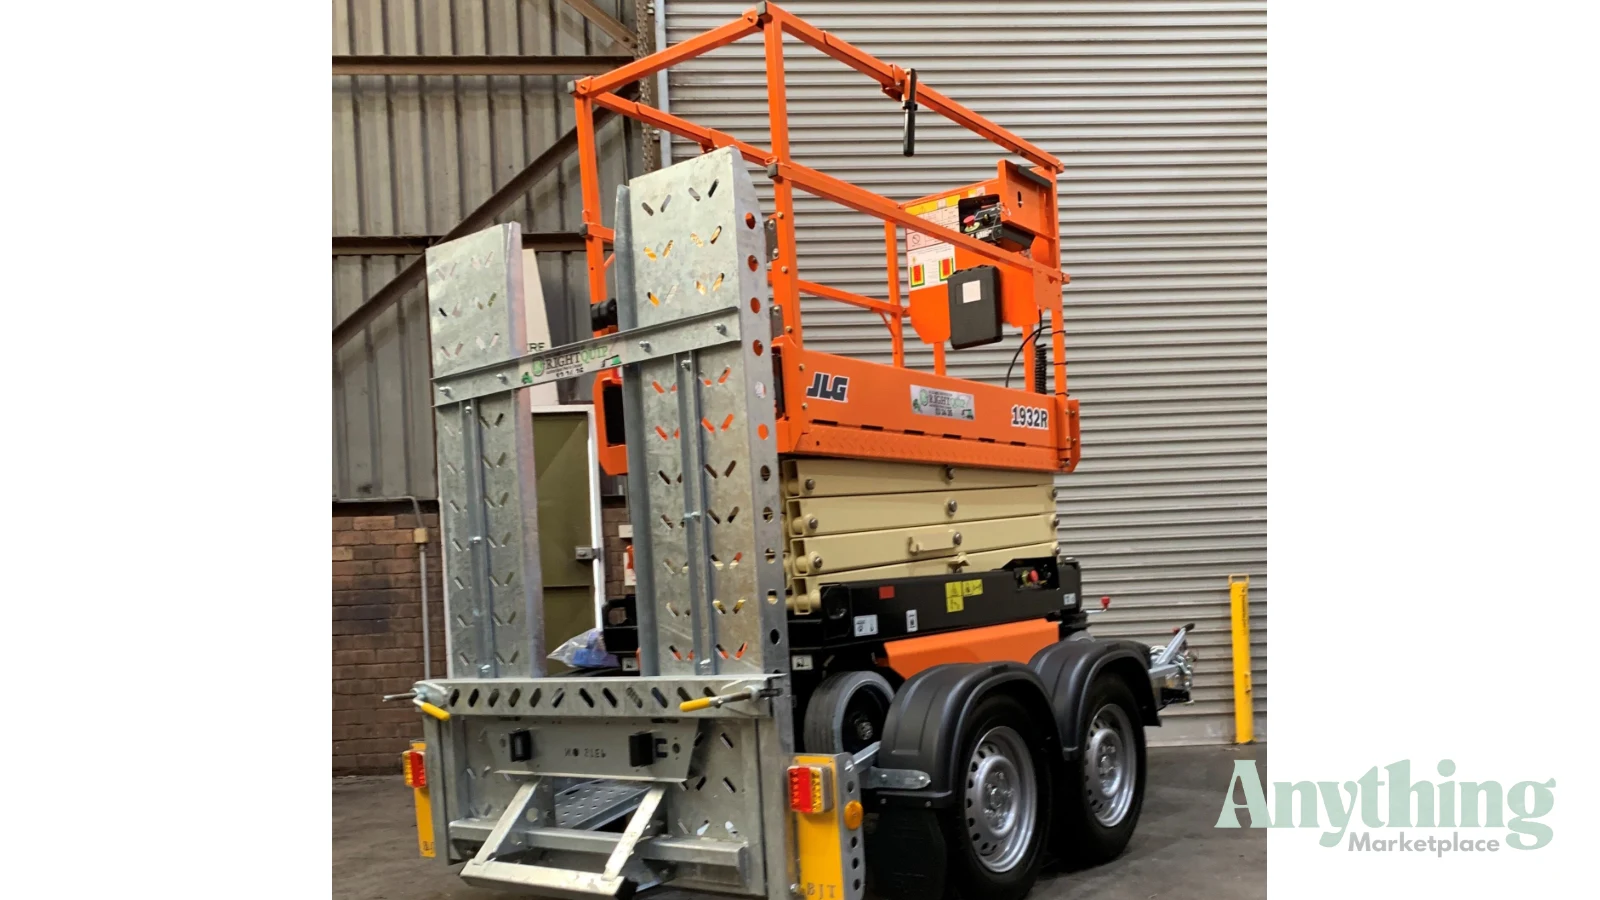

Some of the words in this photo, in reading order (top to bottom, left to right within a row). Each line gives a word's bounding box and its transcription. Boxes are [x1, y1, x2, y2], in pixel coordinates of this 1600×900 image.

[807, 372, 849, 402] JLG
[1012, 405, 1048, 429] 1932R
[806, 882, 836, 899] BJT
